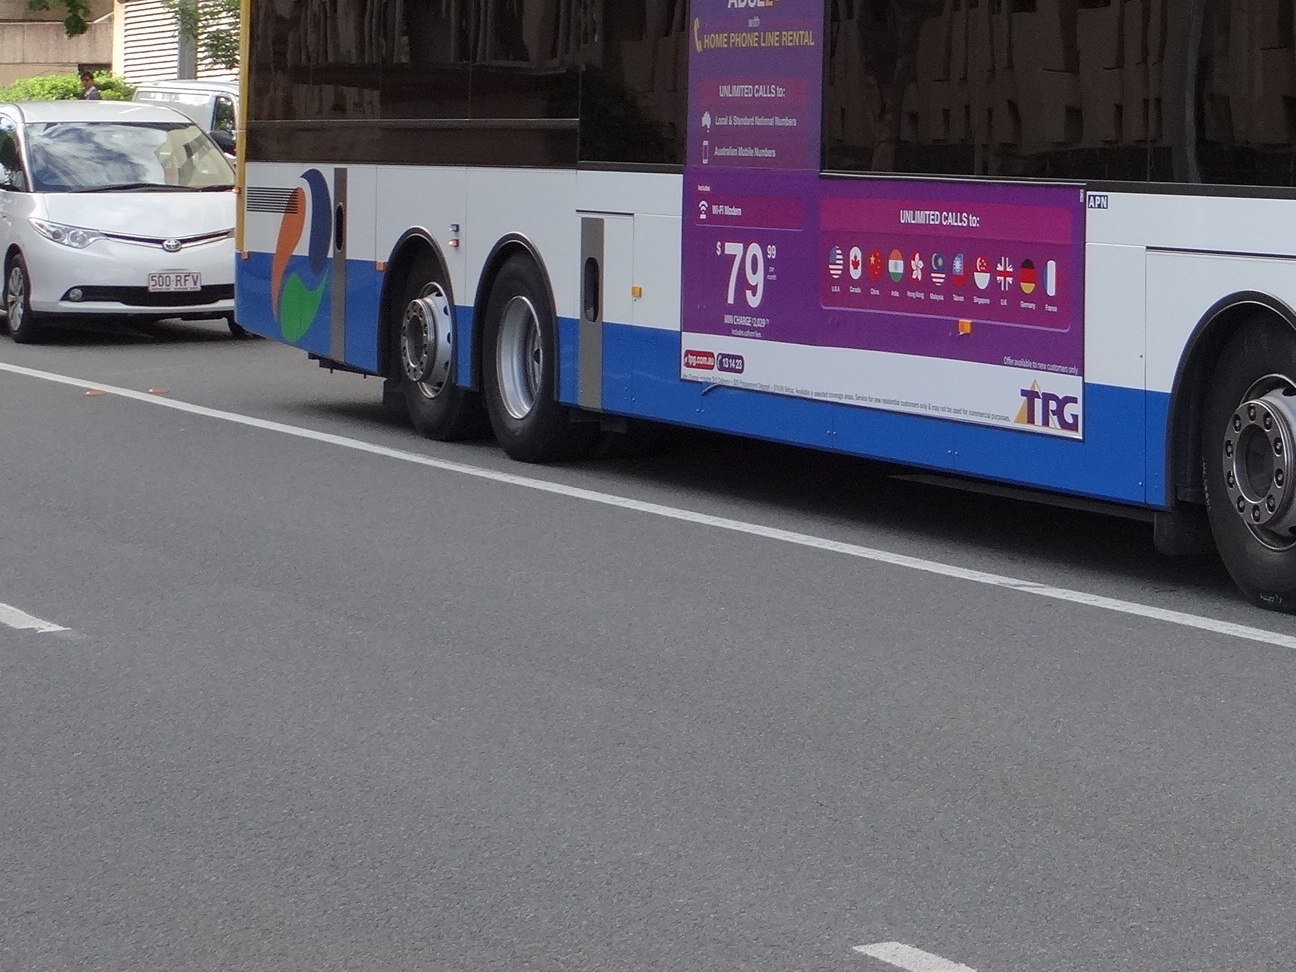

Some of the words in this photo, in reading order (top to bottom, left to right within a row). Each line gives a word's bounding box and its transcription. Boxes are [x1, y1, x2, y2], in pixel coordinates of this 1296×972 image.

[703, 33, 728, 49] HOME
[730, 32, 759, 48] PHONE
[760, 31, 779, 47] LINE
[781, 30, 815, 47] RENTAL
[719, 85, 753, 98] UNLIMITED
[753, 84, 776, 98] CALLS
[775, 116, 797, 127] Numbers
[754, 147, 776, 158] Numbers
[1088, 195, 1107, 208] APN
[900, 209, 941, 226] UNLIMITED
[941, 211, 968, 227] CALLS
[716, 240, 722, 257] $
[724, 241, 765, 308] 79
[766, 244, 777, 260] 99
